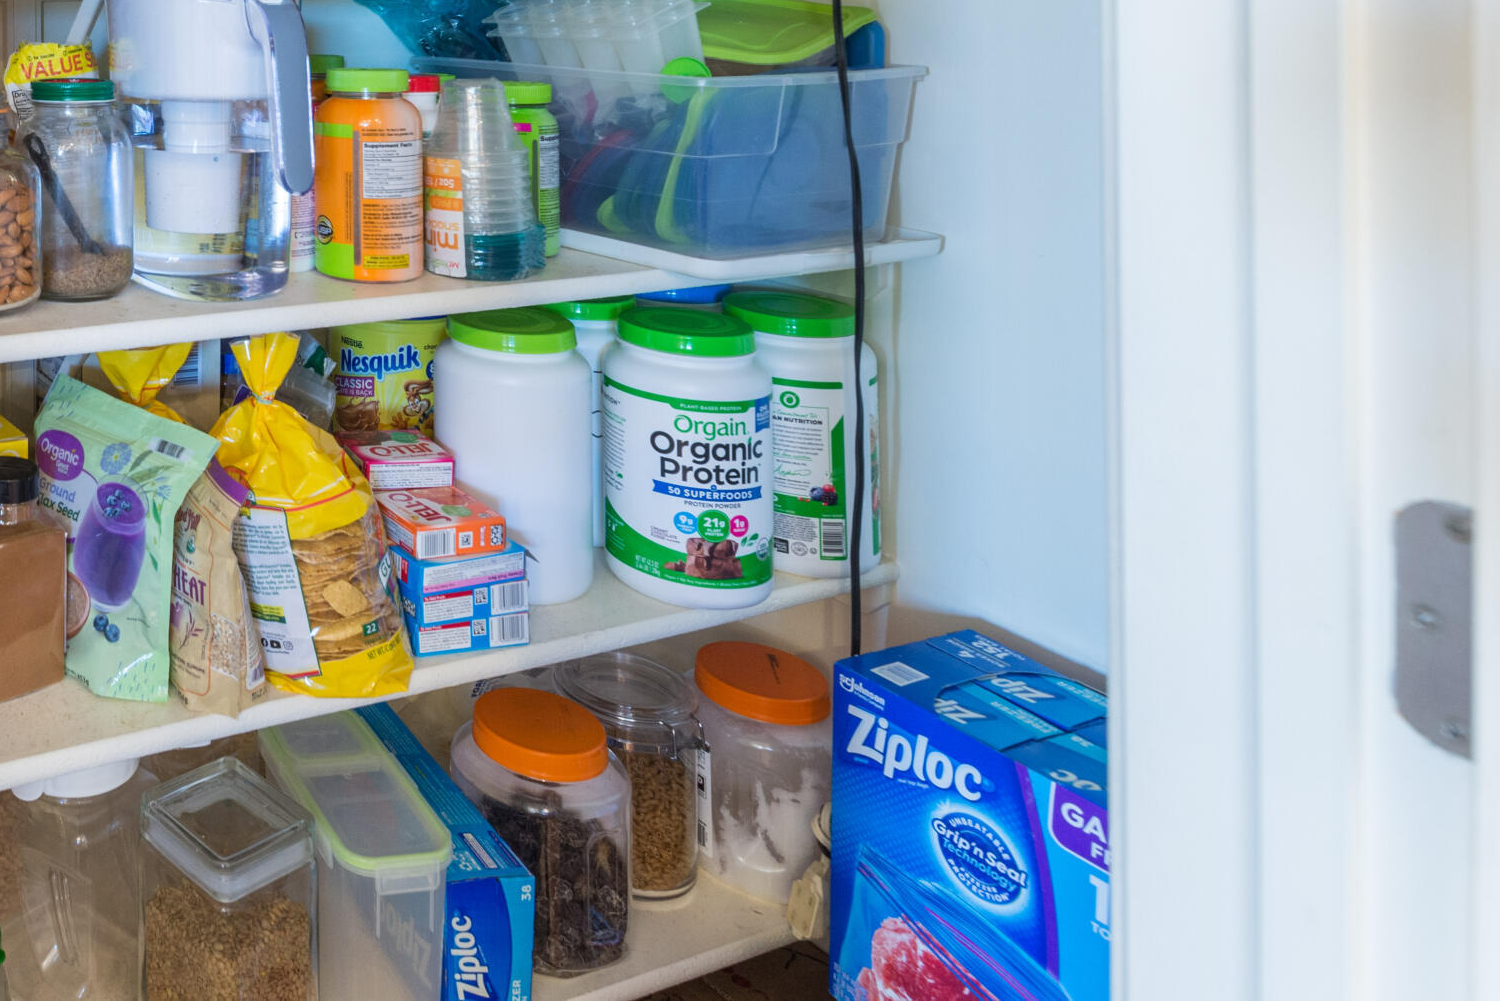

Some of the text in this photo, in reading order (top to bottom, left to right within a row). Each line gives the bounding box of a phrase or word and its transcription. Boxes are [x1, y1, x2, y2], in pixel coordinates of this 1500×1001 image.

[21, 54, 83, 80] VALUE
[341, 344, 420, 381] Nesquik
[336, 378, 373, 390] CLASSIC
[674, 414, 747, 441] Orgain
[41, 437, 79, 466] Organic
[369, 443, 433, 456] JELL-O
[650, 430, 763, 465] Organic
[660, 456, 759, 485] Protein
[39, 477, 76, 503] Ground
[668, 486, 753, 500] 50 SUPERFOODS
[684, 500, 713, 508] PROTEIN
[57, 502, 81, 522] Seed
[388, 492, 452, 522] JELL-O
[703, 517, 726, 528] 21g
[733, 518, 745, 527] 1g
[174, 566, 206, 606] HEAT
[366, 623, 377, 634] 22
[846, 704, 982, 802] Ziploc
[1061, 802, 1108, 844] GA
[949, 817, 1011, 861] UNBEATABLE
[942, 837, 1018, 892] Technology
[985, 852, 1027, 887] Seal
[521, 884, 532, 901] 38
[948, 858, 1009, 902] PROTECTION
[959, 866, 998, 893] FREEZER
[451, 915, 490, 1001] Ziploc
